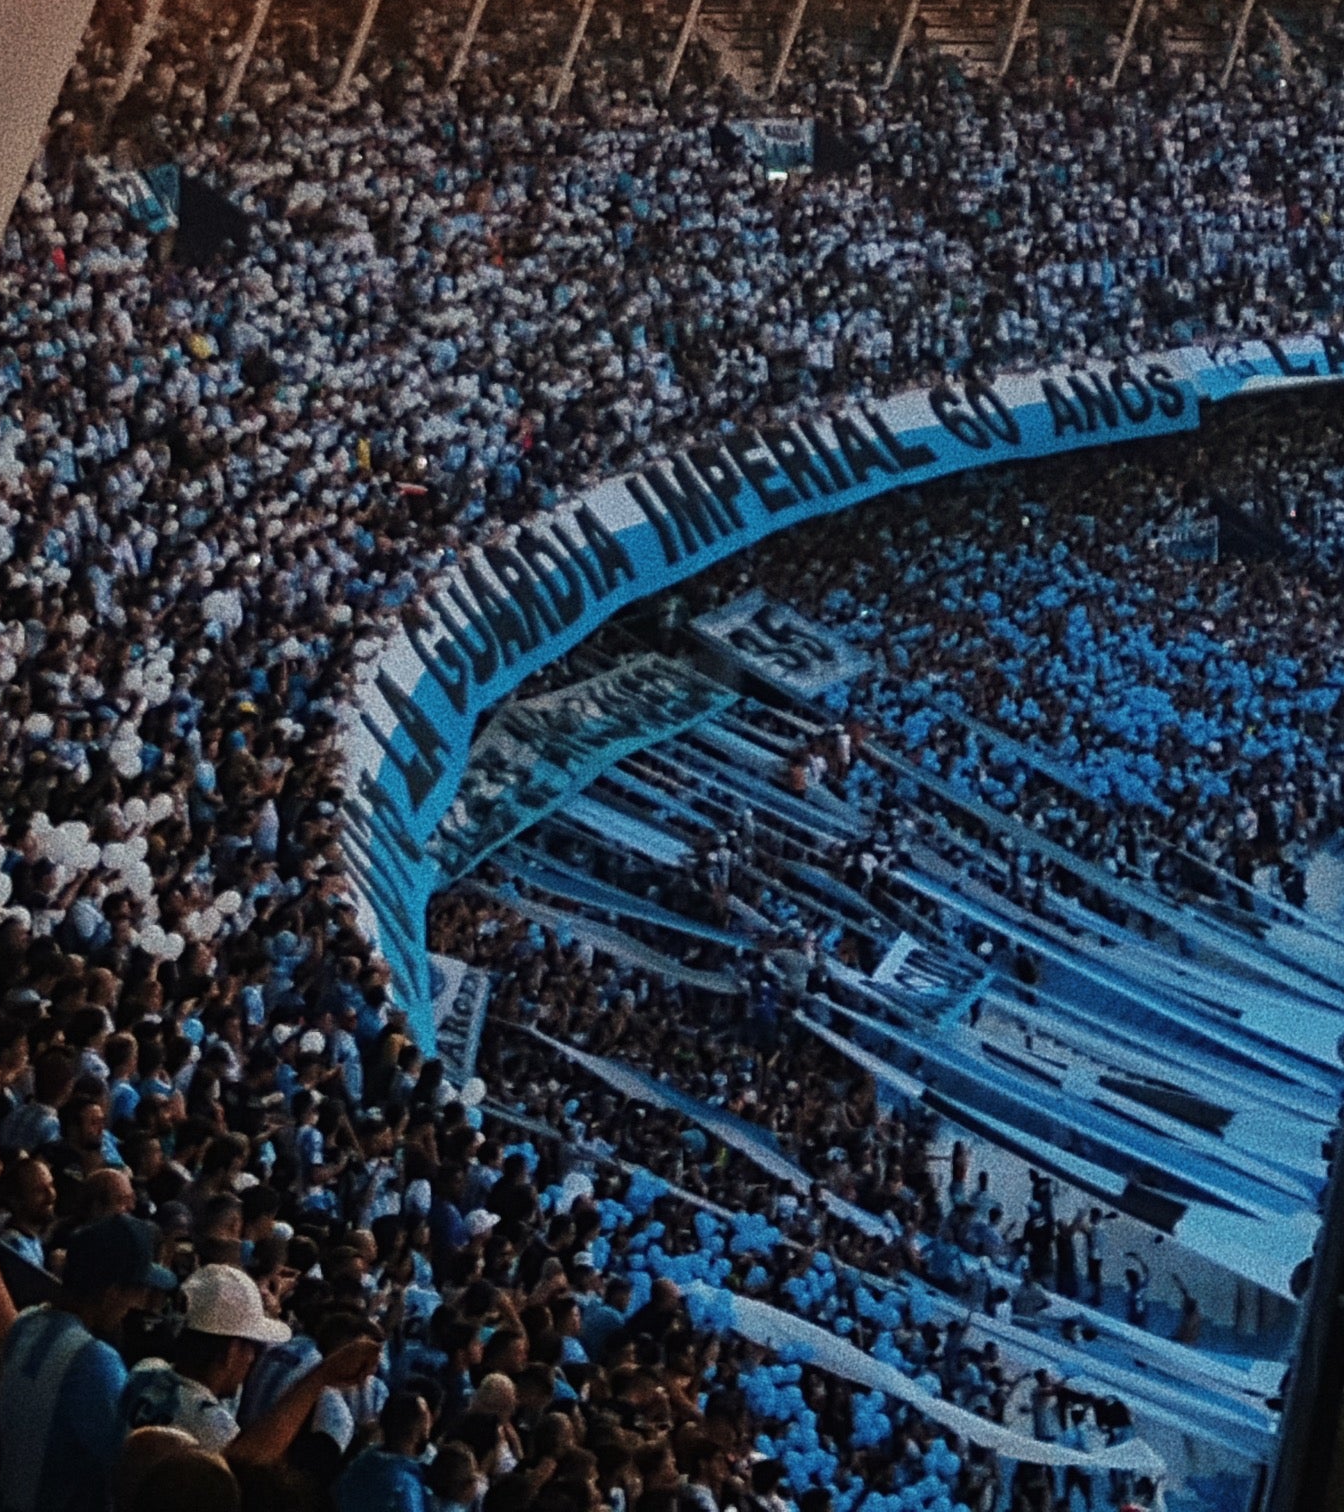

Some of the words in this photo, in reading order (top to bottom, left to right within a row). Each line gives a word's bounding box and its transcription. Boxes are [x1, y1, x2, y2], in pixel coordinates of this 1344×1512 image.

[624, 405, 939, 567] IMPERIAL
[928, 375, 1020, 450] 60
[403, 501, 636, 717] GUARDIA
[359, 665, 453, 813] LA
